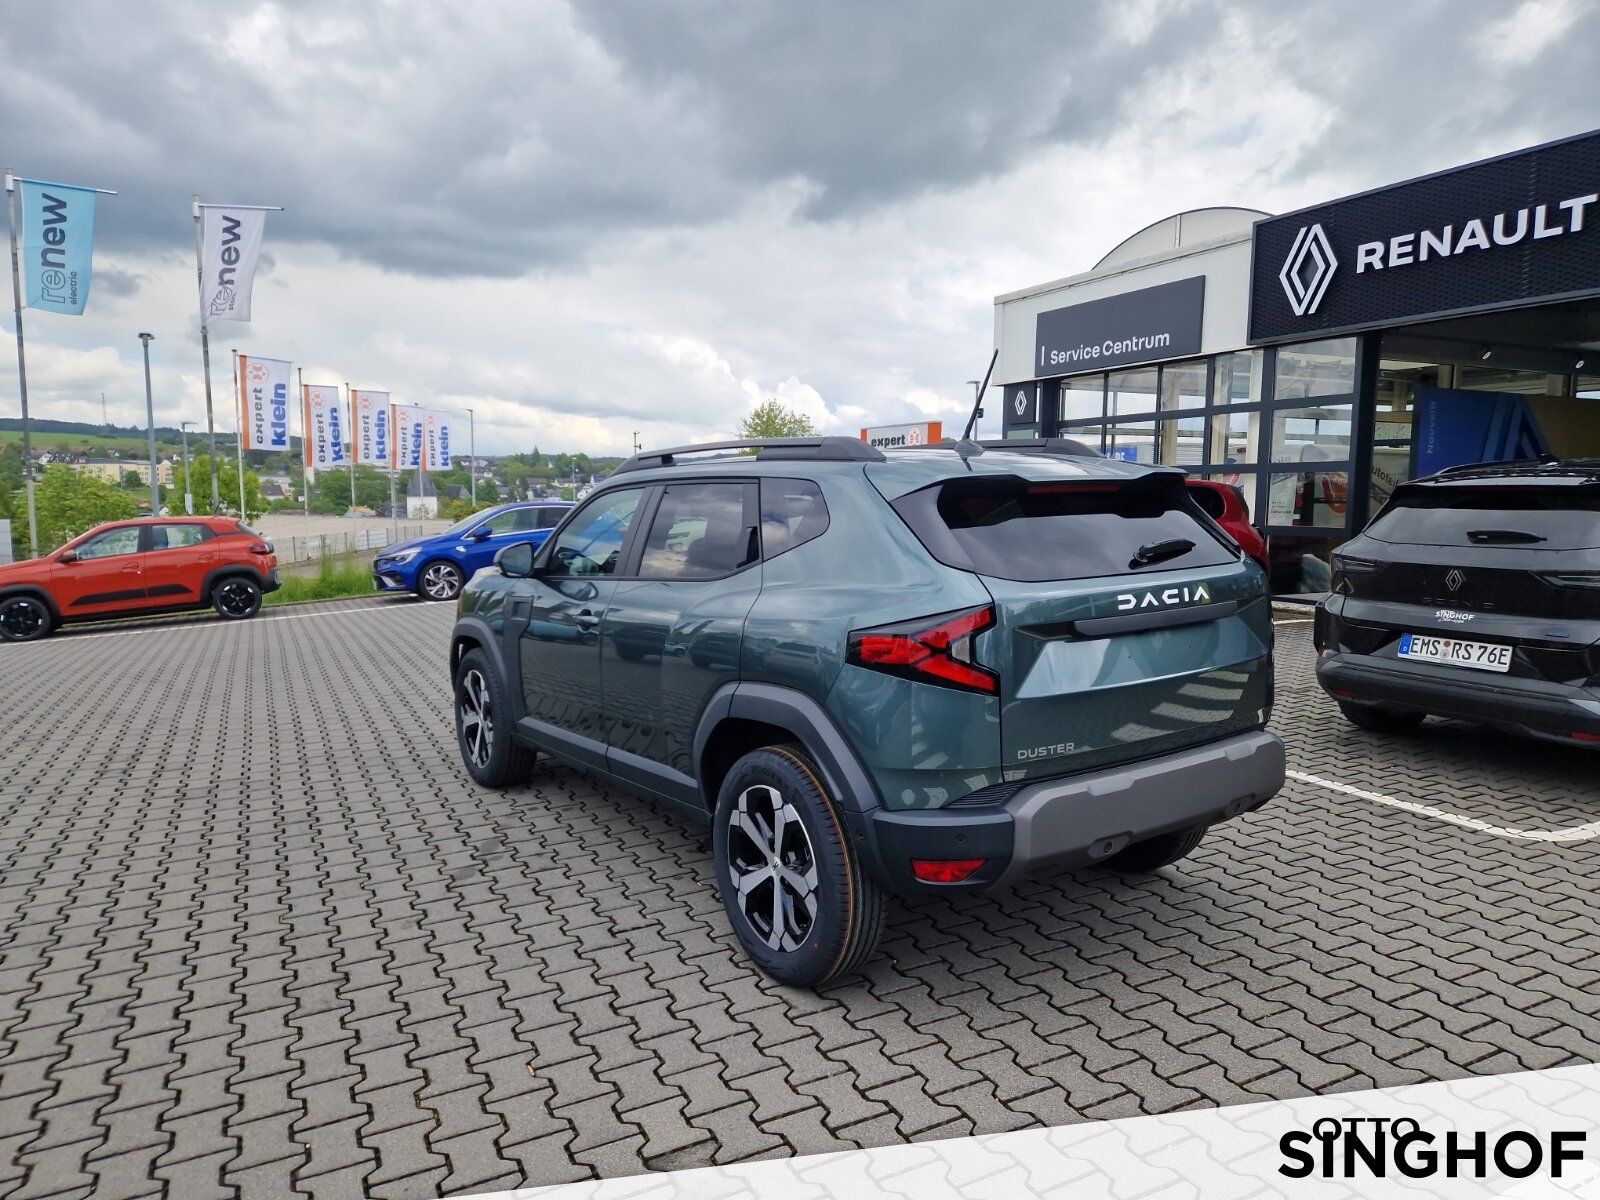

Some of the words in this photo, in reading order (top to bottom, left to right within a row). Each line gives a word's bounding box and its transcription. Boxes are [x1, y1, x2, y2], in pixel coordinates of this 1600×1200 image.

[41, 192, 68, 304] renew
[1356, 193, 1599, 274] RENAULT
[210, 215, 241, 315] renew
[1050, 344, 1100, 365] Service
[1102, 332, 1170, 356] Centrum
[253, 387, 263, 444] expert
[271, 383, 287, 446] klein
[329, 407, 344, 462] klein
[375, 409, 387, 460] klein
[316, 412, 326, 463] expert
[362, 414, 371, 460] expert
[400, 426, 408, 466] expert
[410, 422, 422, 466] klein
[438, 426, 449, 467] klein
[871, 434, 906, 449] expert
[1372, 465, 1398, 487] utoteil
[1117, 586, 1210, 611] DACIA
[1435, 611, 1475, 621] SINGHOF
[1410, 637, 1441, 656] EMS
[1451, 642, 1473, 660] RS
[1477, 646, 1509, 665] 76E
[1017, 743, 1075, 760] DUSTER
